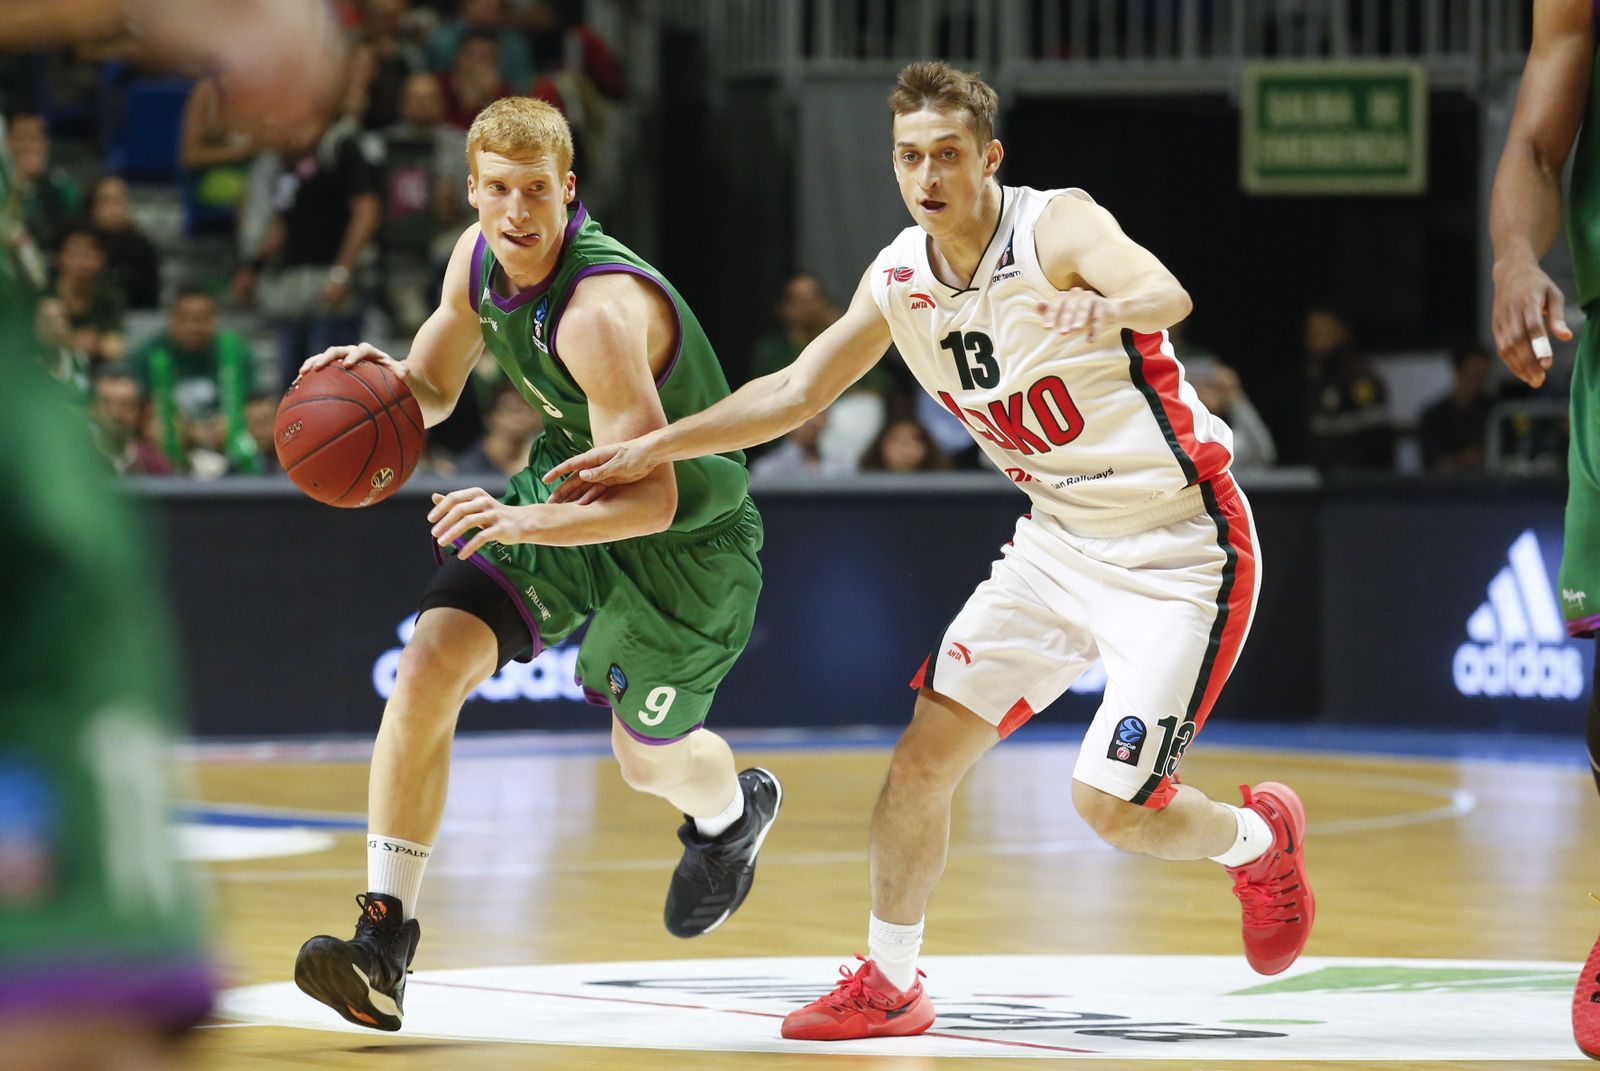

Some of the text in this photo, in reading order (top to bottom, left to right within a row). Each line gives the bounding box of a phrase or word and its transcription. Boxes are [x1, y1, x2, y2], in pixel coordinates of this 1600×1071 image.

[910, 301, 928, 311] ANTA
[940, 331, 1000, 390] 13
[1066, 467, 1114, 487] Railways
[1452, 638, 1585, 700] adidas
[638, 686, 676, 726] 9
[1152, 714, 1197, 778] 13
